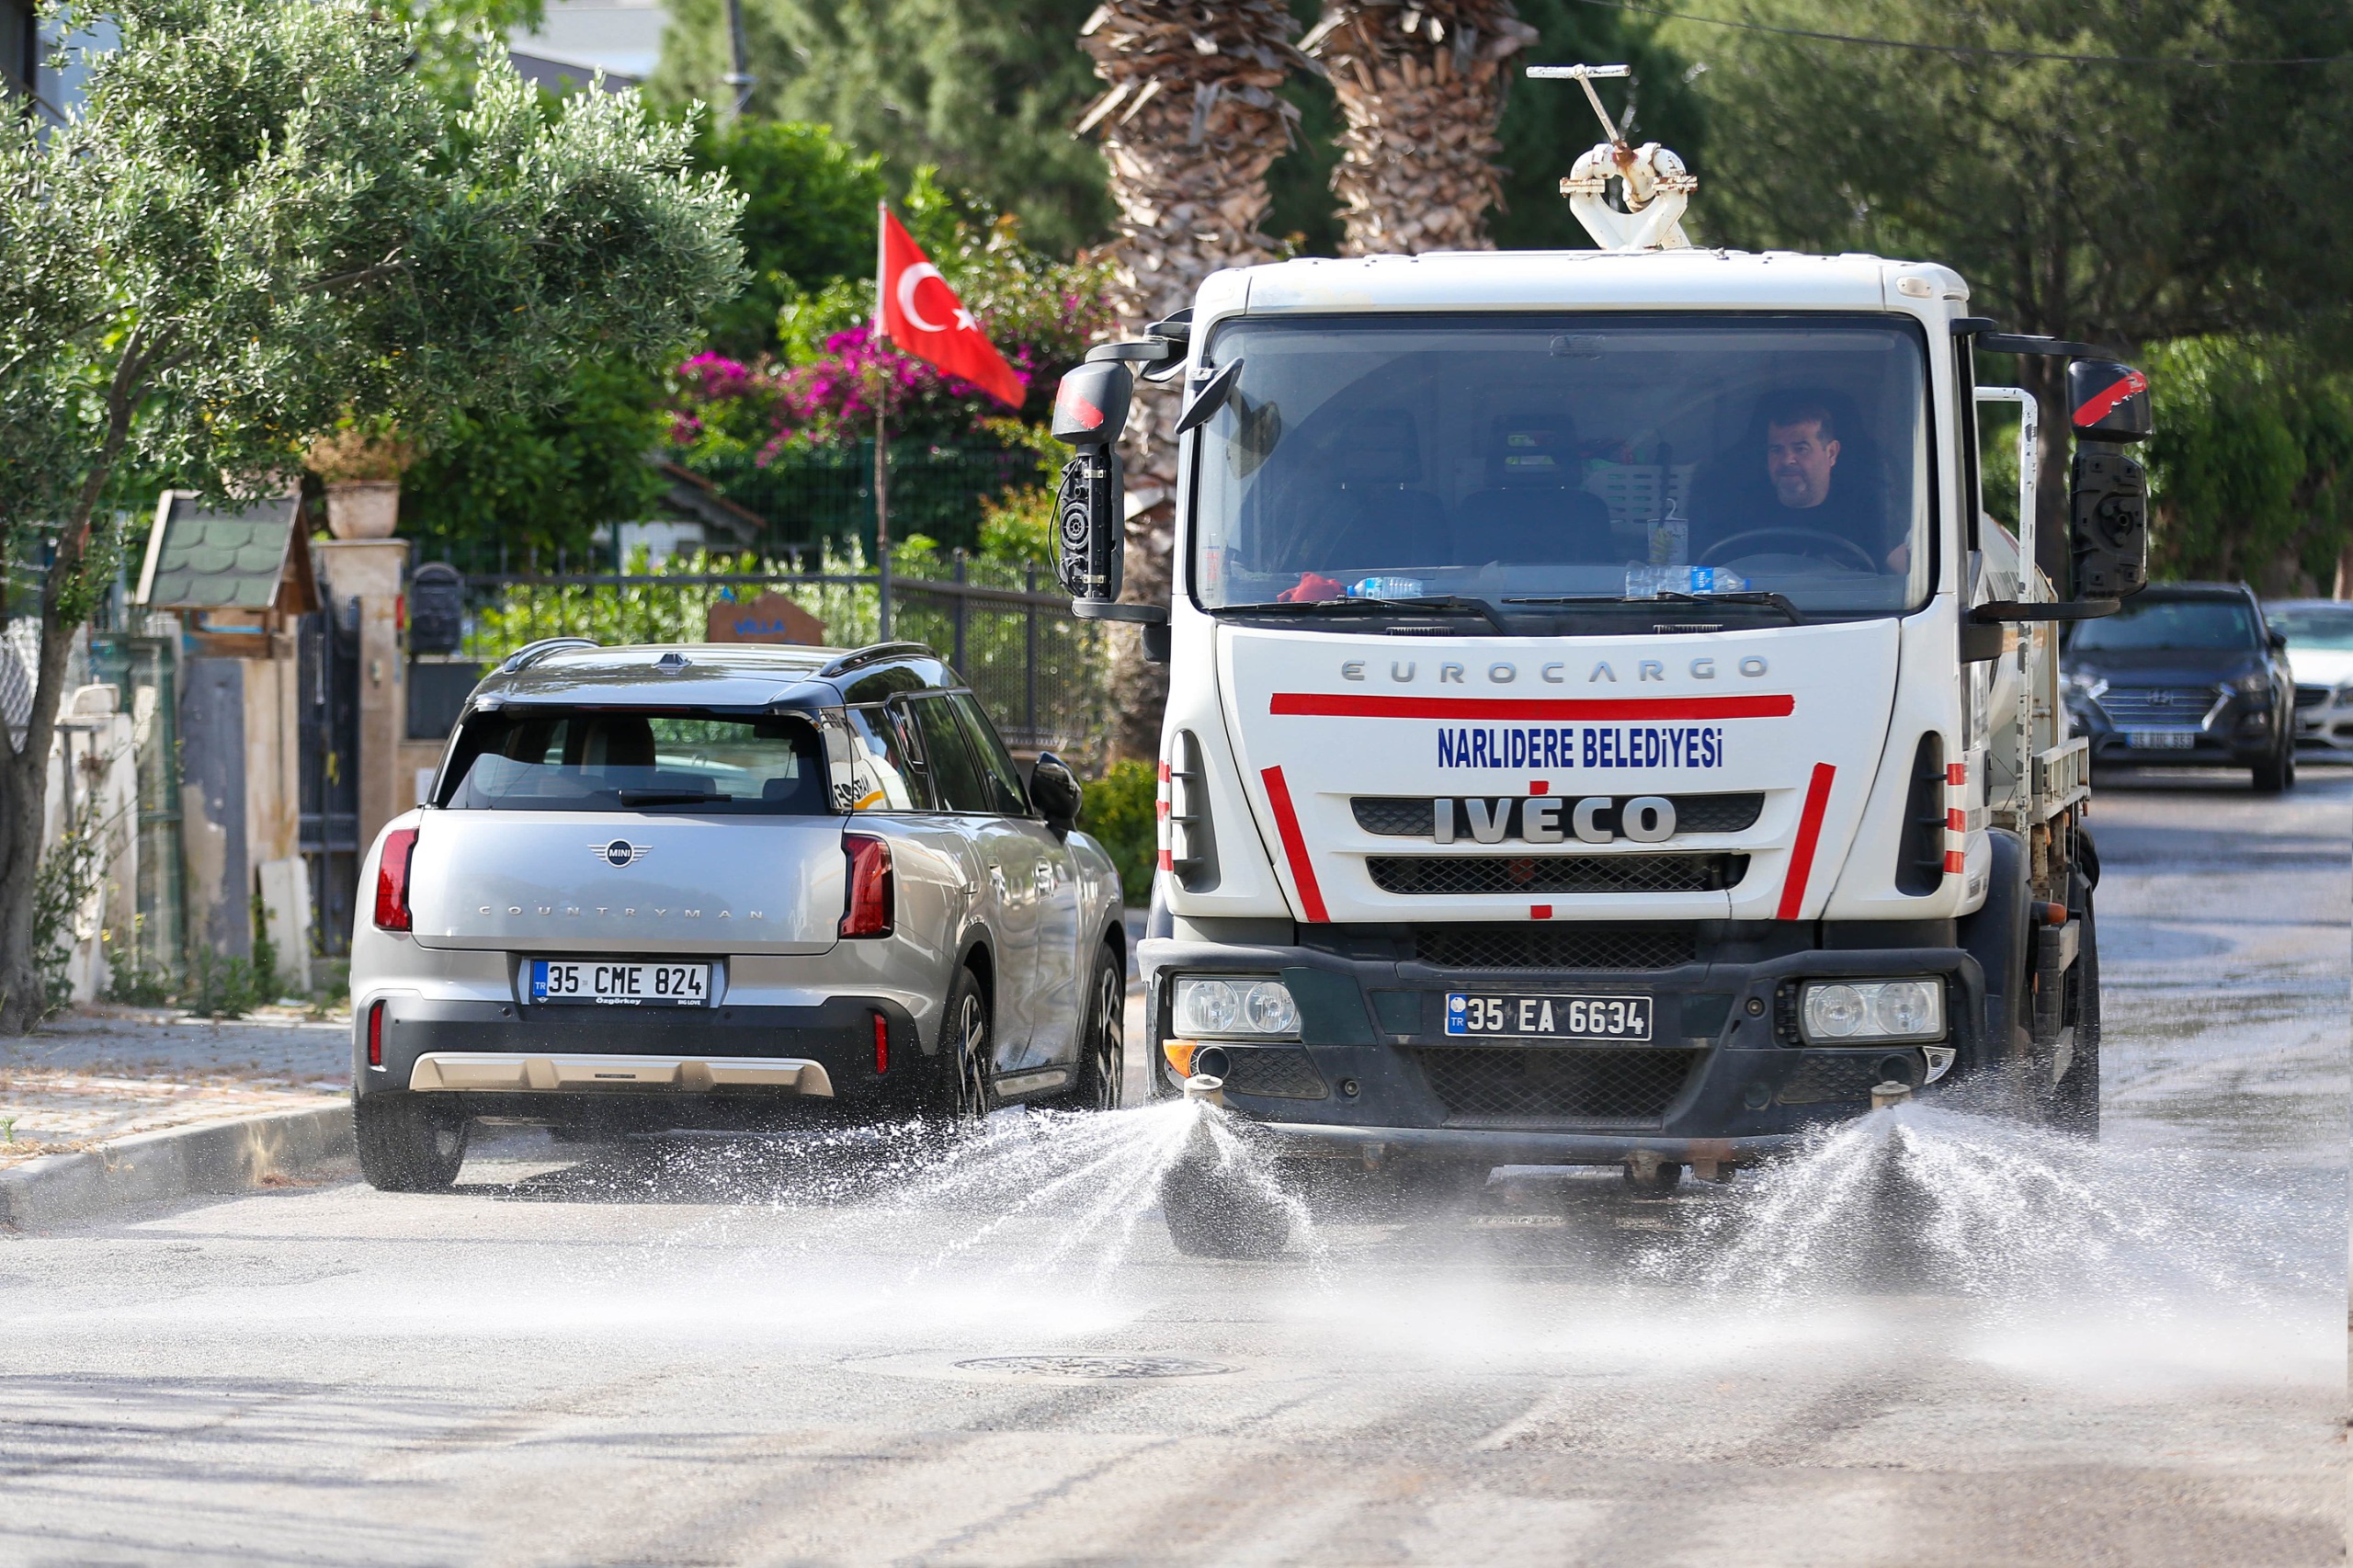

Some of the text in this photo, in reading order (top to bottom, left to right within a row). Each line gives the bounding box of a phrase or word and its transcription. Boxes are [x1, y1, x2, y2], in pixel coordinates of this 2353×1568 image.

[1341, 655, 1769, 683] EUROCARGO
[1438, 728, 1574, 768] NARLIDERE
[1433, 796, 1677, 845] IVECO
[608, 848, 631, 858] MINI
[479, 905, 763, 919] COUNTRYMAN
[535, 982, 546, 991] TR
[549, 966, 701, 996] 35 CME 824
[595, 996, 642, 1006] Özgörkey
[1450, 1017, 1464, 1027] TR
[1467, 998, 1644, 1035] 35 EA 6634
